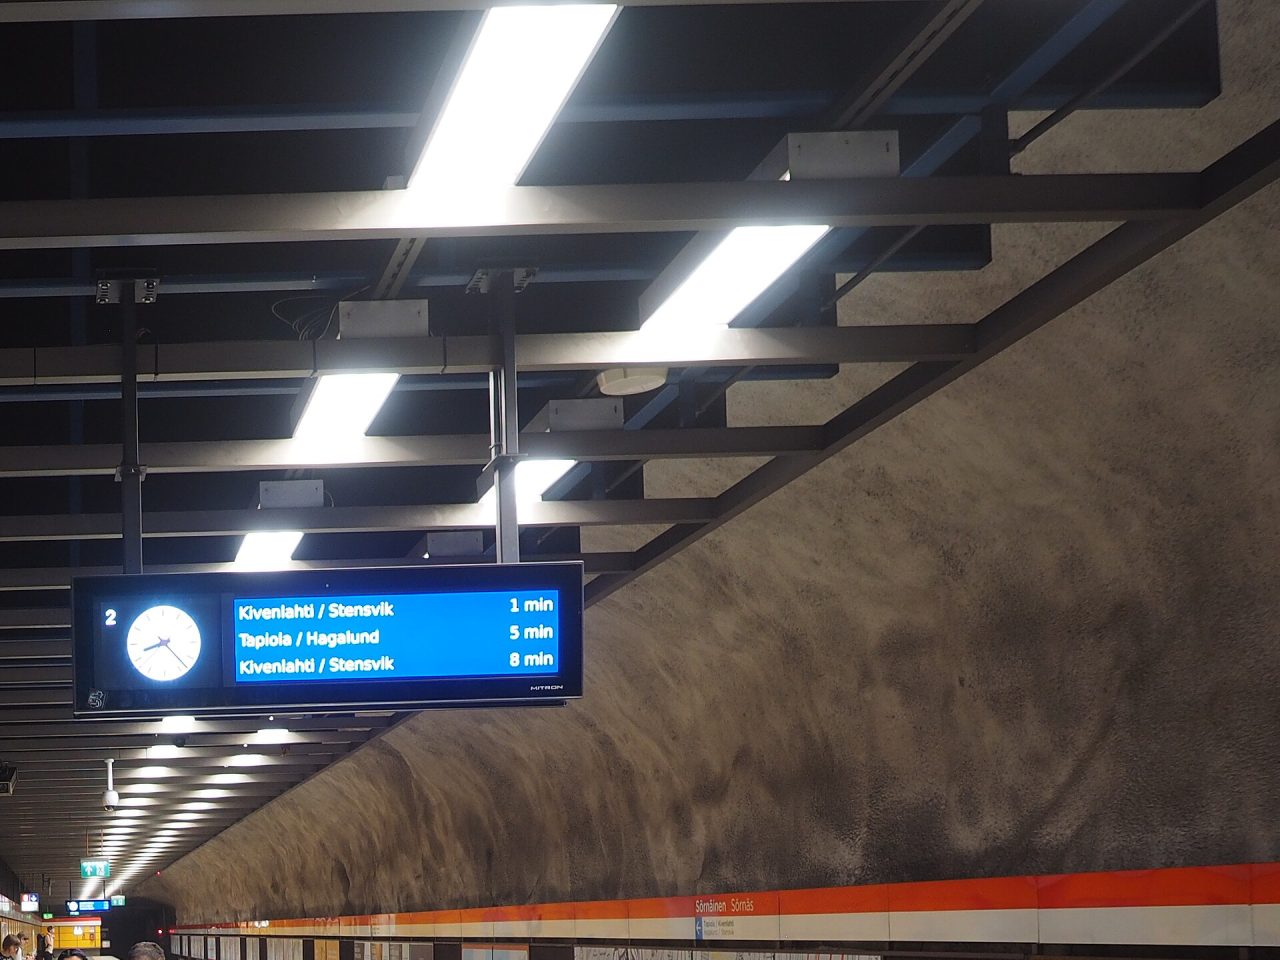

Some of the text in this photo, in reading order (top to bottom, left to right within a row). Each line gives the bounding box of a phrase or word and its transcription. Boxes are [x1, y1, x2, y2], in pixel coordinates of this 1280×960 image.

[238, 601, 394, 620] Kivenlahti / Stensvik
[510, 597, 554, 612] 1 min
[105, 609, 117, 626] 2
[238, 628, 380, 650] Tapiola / Hagalund
[509, 624, 553, 640] 5 min
[239, 655, 394, 675] Kivenlahti / Stensvik
[509, 651, 554, 667] 8 min
[695, 897, 754, 913] Sörnäinen Sörnäs
